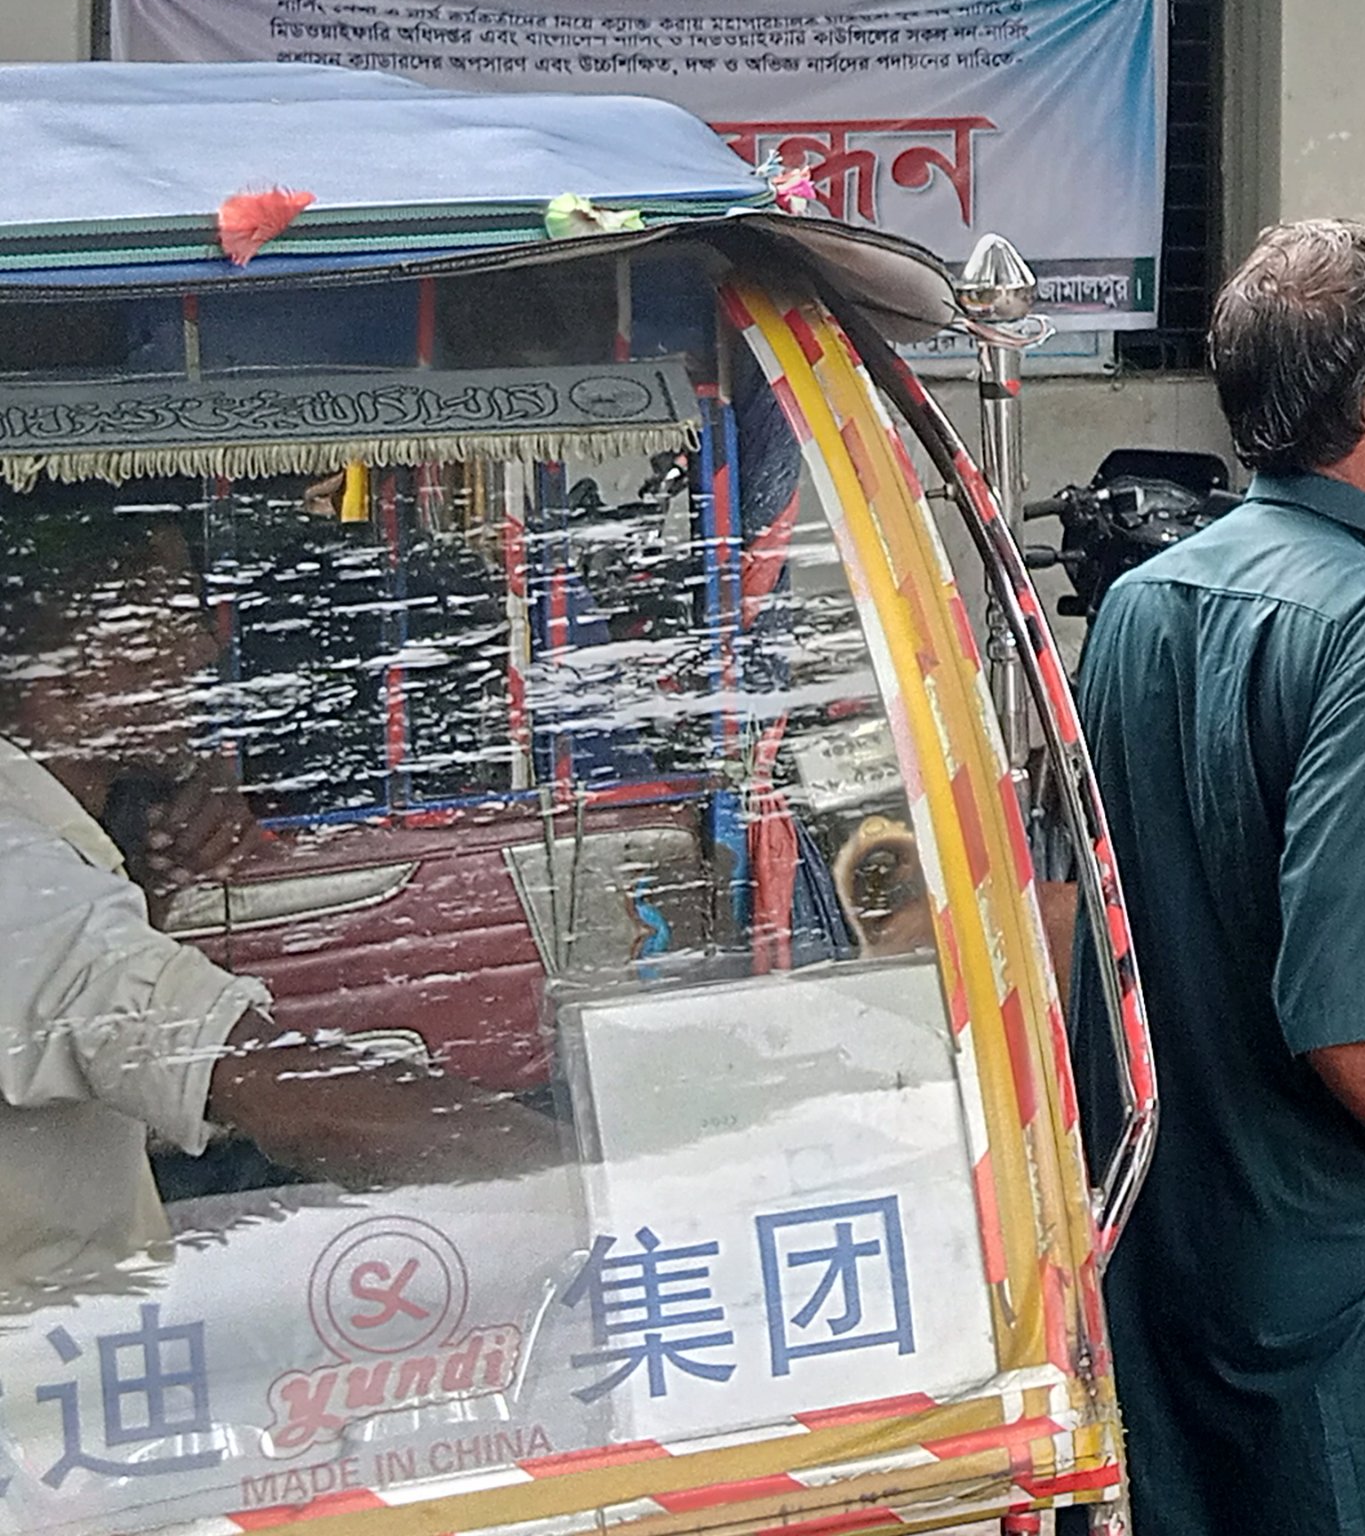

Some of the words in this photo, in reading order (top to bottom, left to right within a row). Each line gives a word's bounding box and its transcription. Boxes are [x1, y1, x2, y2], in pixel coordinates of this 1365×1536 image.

[560, 1193, 918, 1404] 集团
[240, 1456, 361, 1507] MADE
[376, 1452, 416, 1483] IN
[428, 1423, 552, 1473] CHINA
